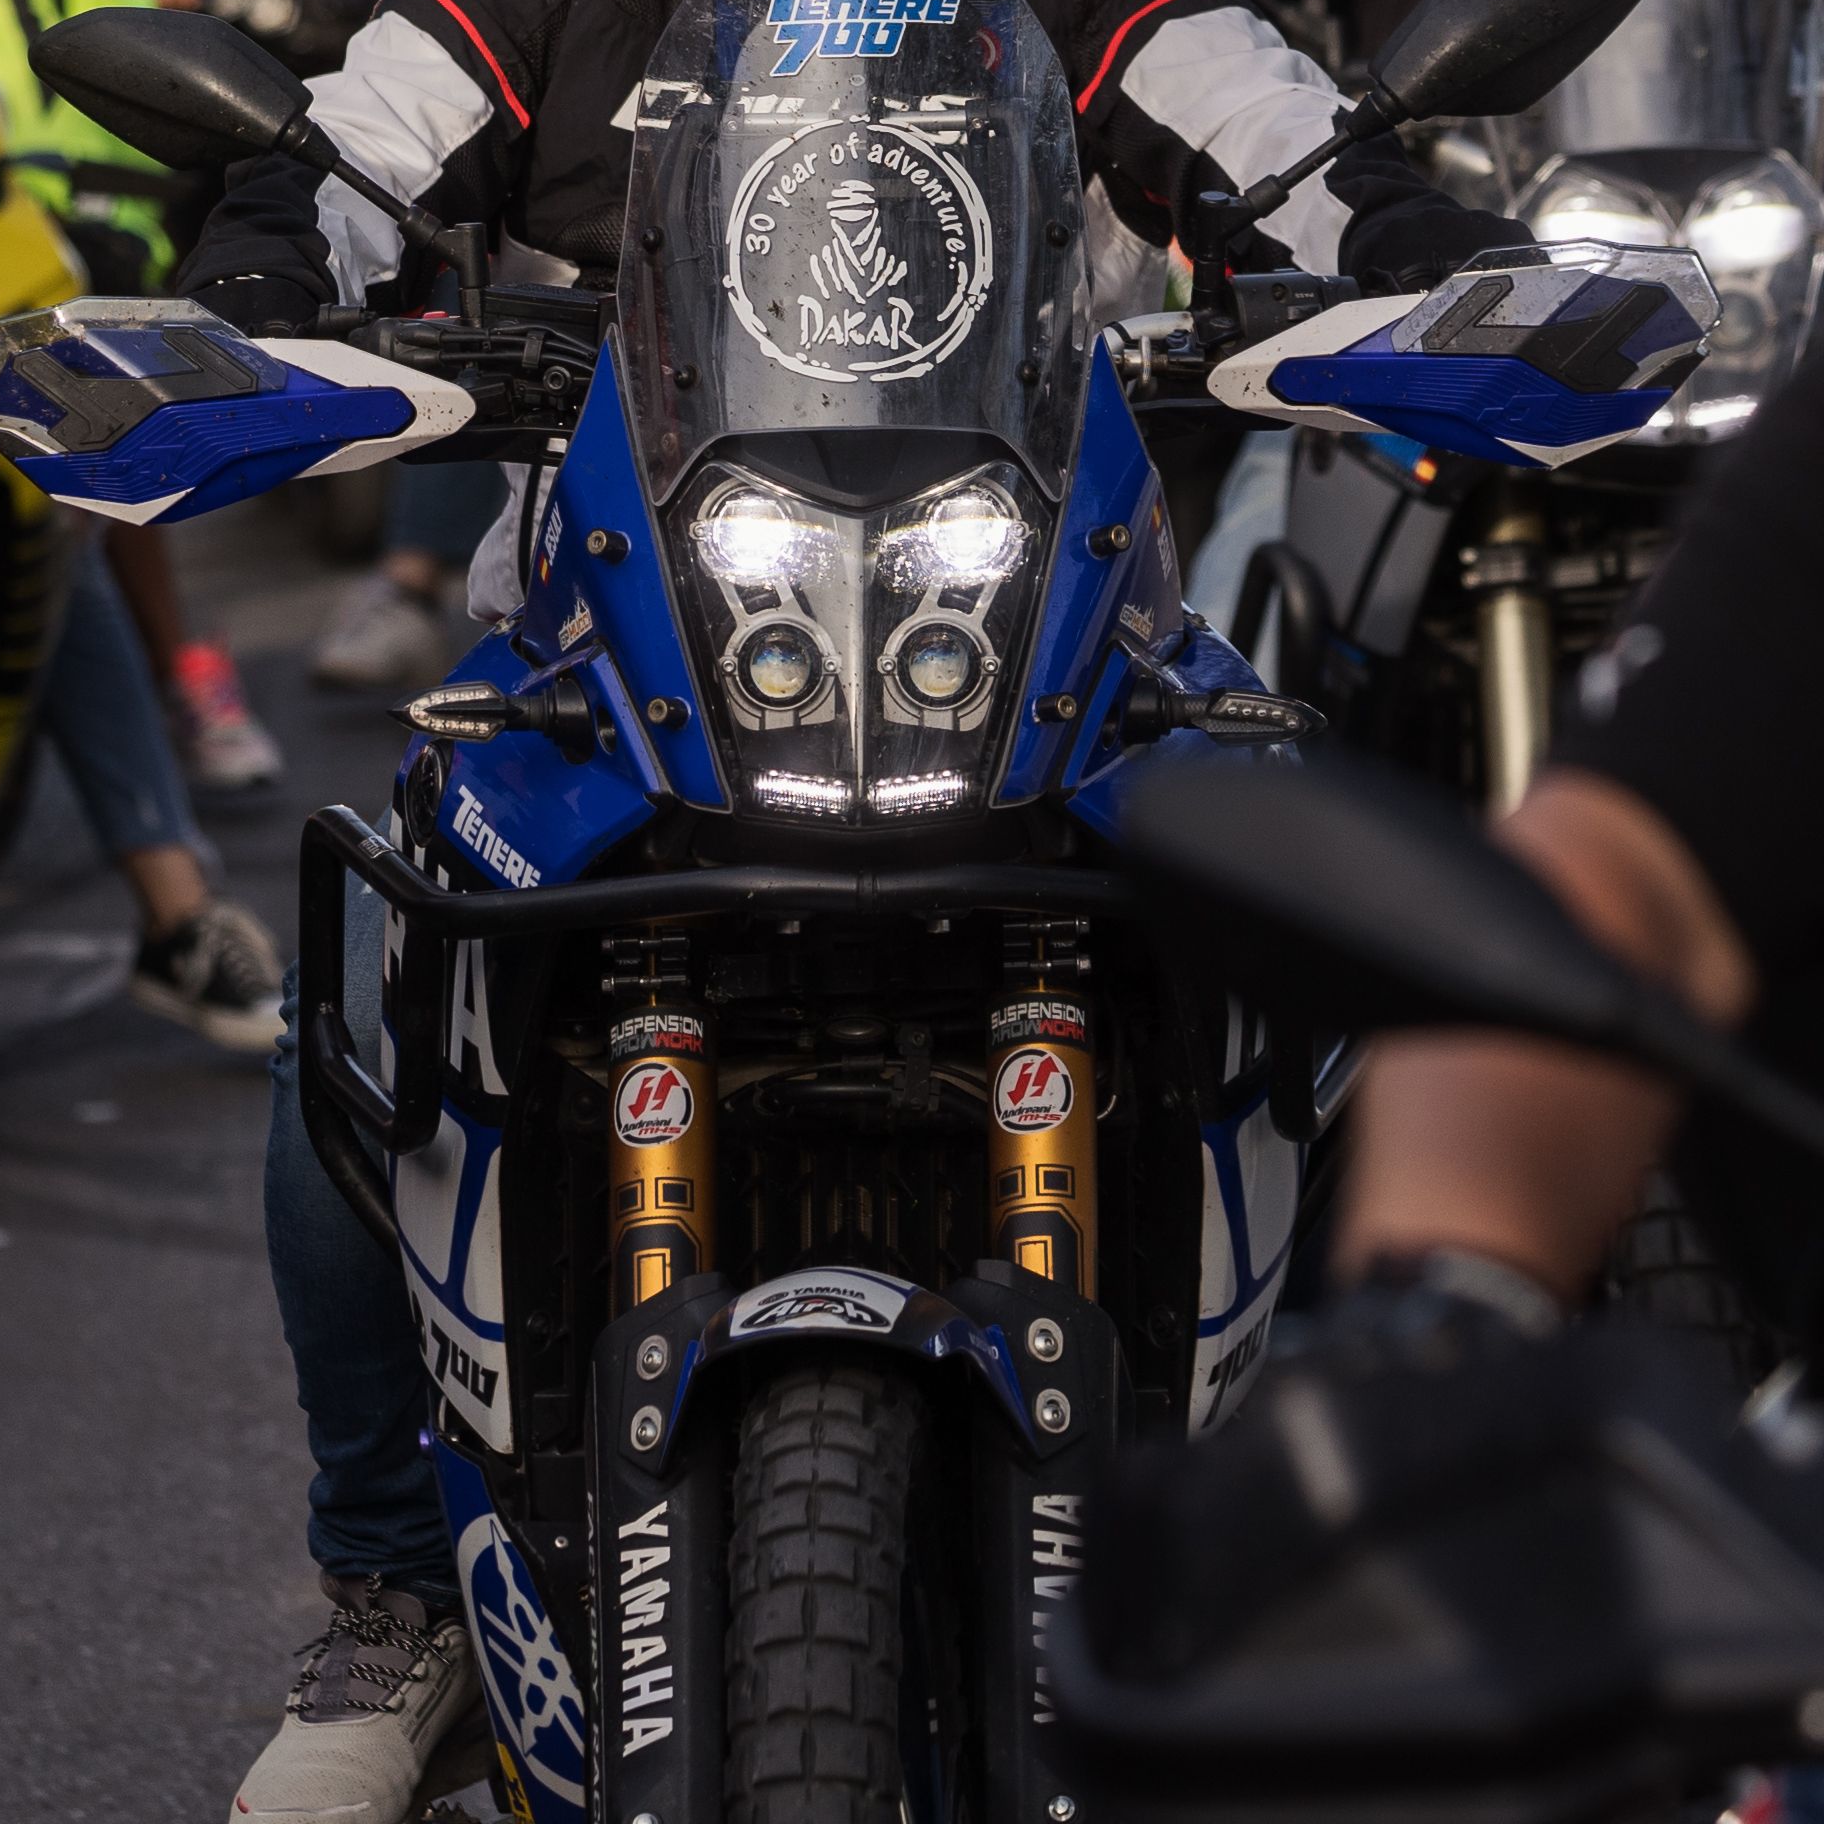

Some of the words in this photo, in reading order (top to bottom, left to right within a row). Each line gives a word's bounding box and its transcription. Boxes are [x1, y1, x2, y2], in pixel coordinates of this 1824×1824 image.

[769, 21, 907, 76] 700
[745, 213, 776, 255] 30
[766, 152, 818, 208] year
[830, 132, 860, 165] of
[796, 294, 923, 350] DAKAR
[622, 1117, 672, 1134] Andreani
[1001, 1105, 1053, 1121] Andreani
[793, 1286, 866, 1300] YAMAHA
[430, 1317, 499, 1408] 700
[618, 1500, 674, 1758] YAMAHA
